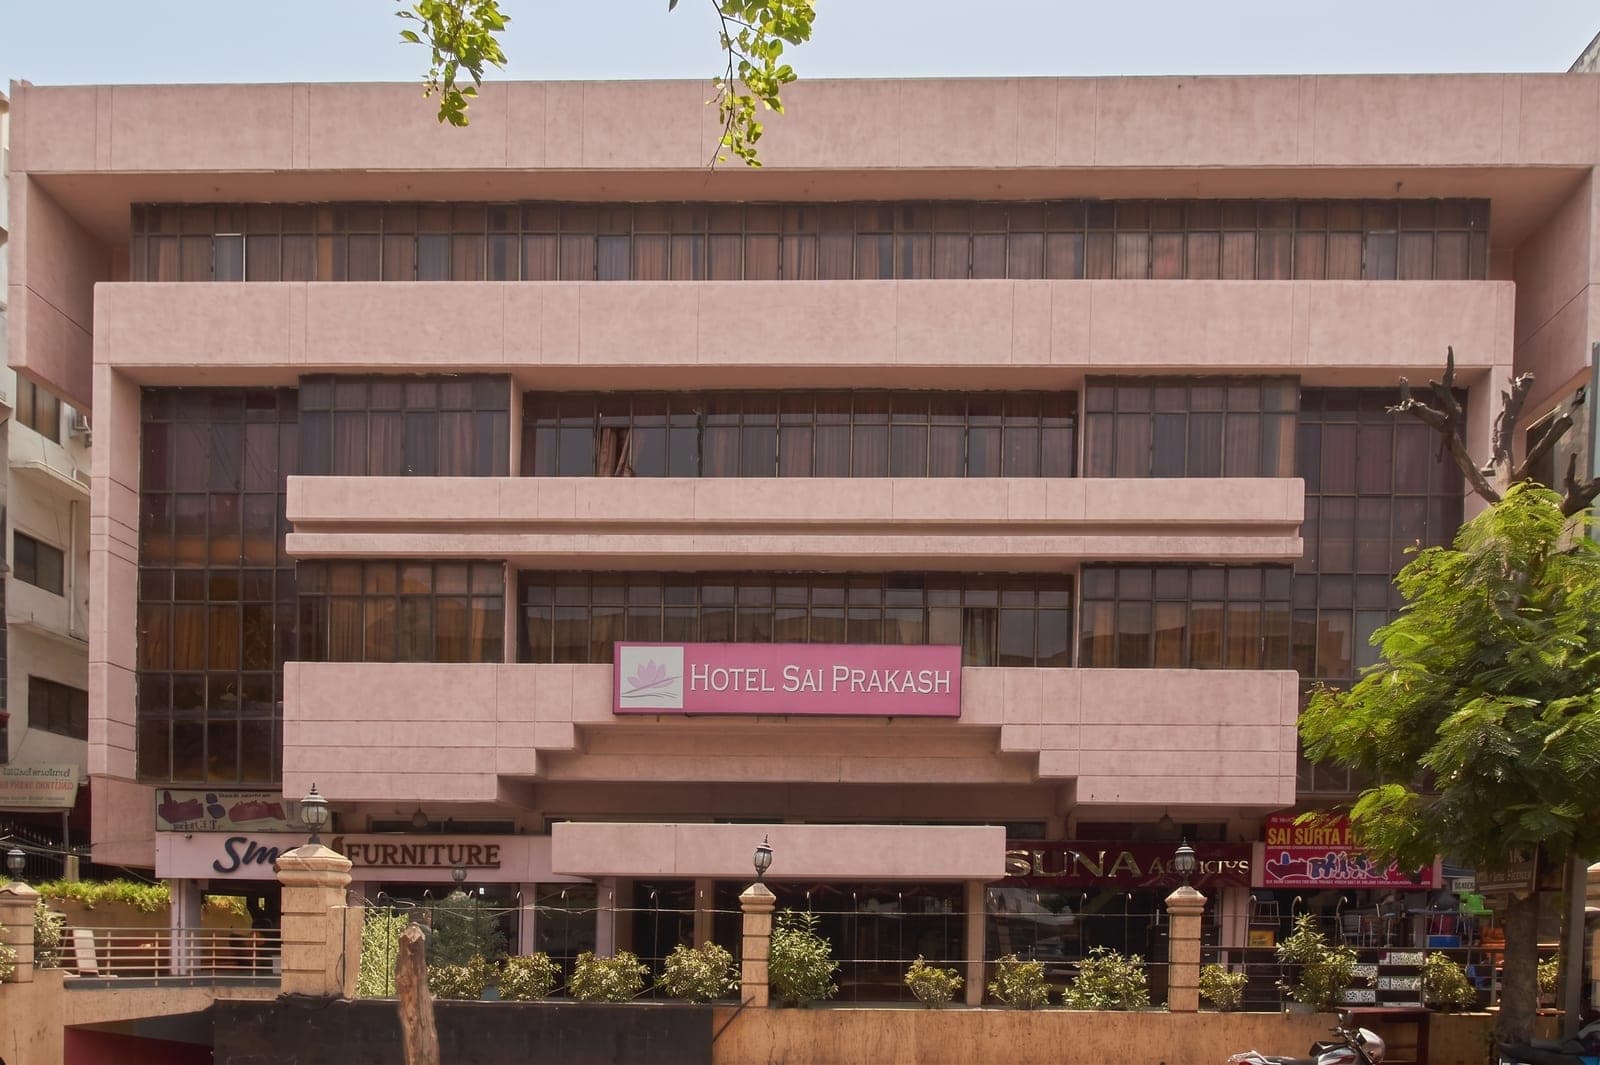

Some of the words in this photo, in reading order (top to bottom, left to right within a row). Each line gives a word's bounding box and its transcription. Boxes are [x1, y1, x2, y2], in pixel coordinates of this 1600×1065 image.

[690, 663, 775, 692] HOTEL
[782, 664, 824, 693] SAI
[832, 665, 951, 694] PRAKASH
[1268, 827, 1291, 846] SAI
[346, 844, 501, 865] FURNITURE
